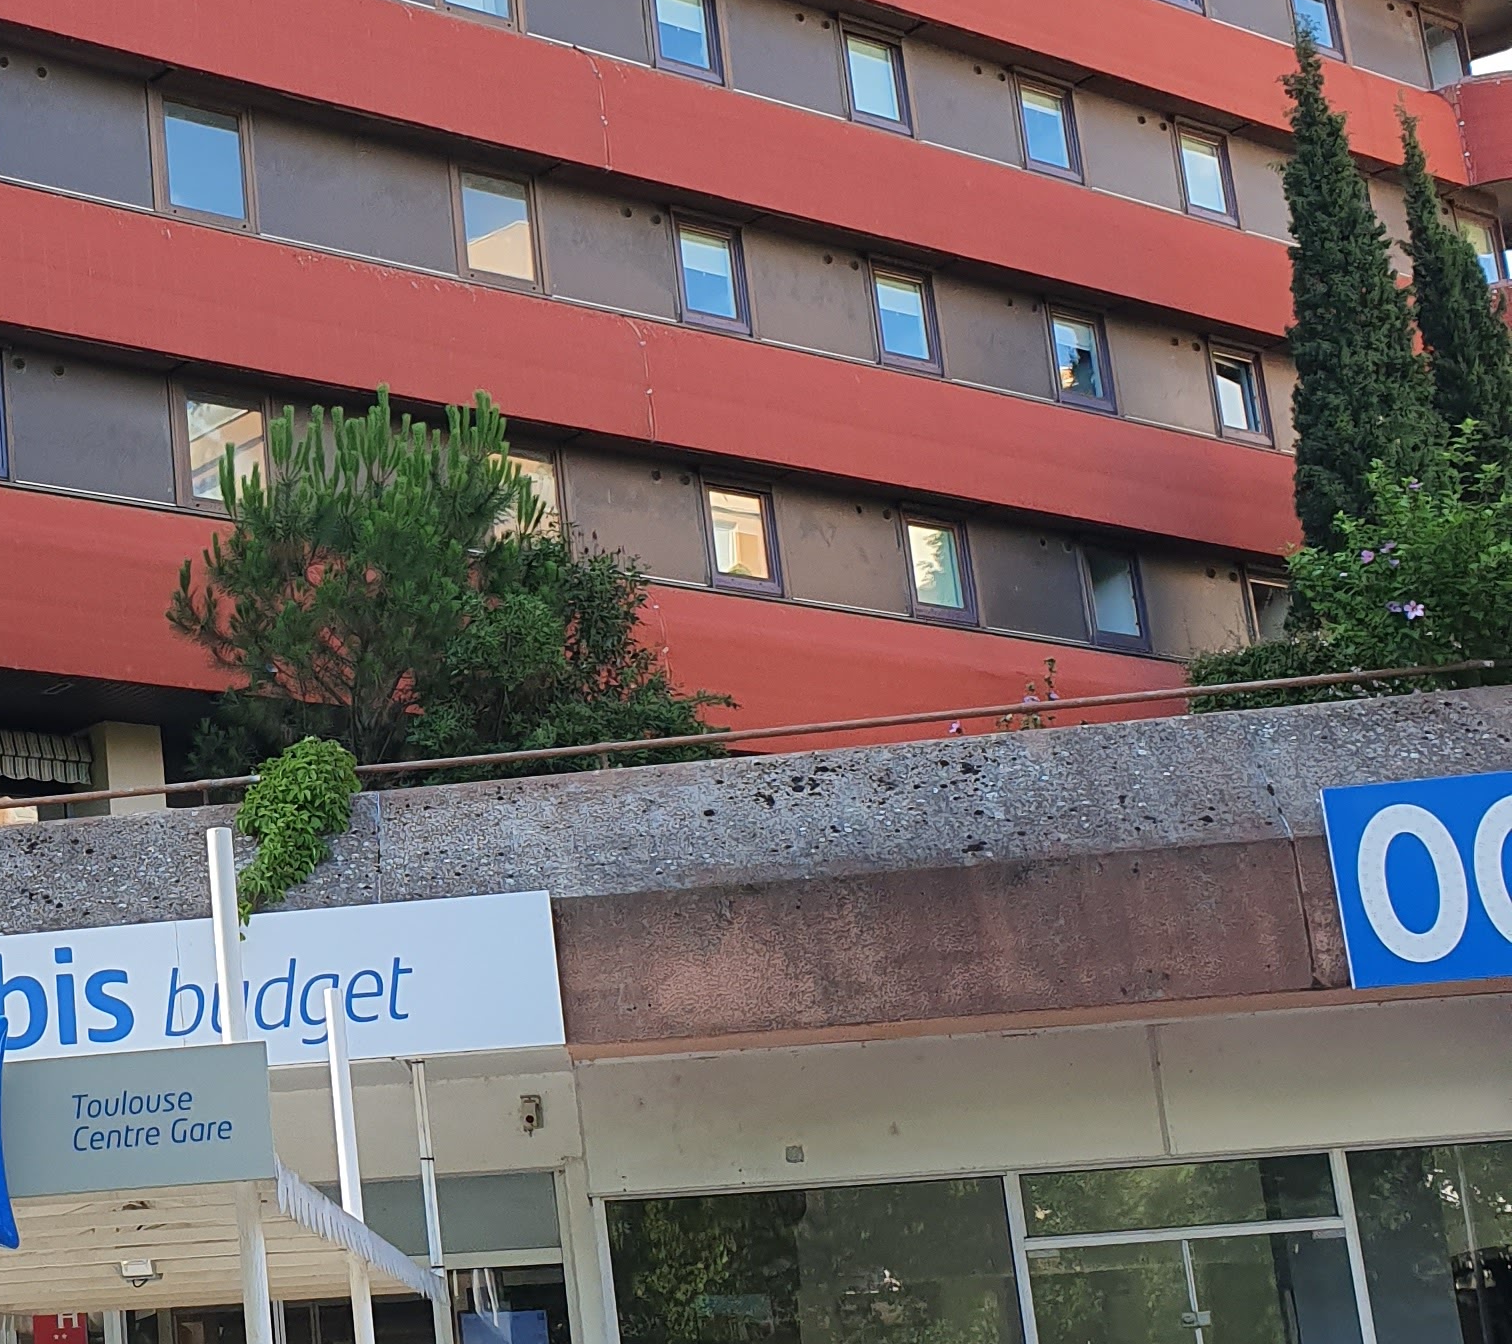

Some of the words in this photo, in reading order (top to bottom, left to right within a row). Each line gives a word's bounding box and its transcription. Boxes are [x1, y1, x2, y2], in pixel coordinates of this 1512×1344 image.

[72, 1090, 193, 1120] Toulouse
[73, 1125, 161, 1152] Centre
[171, 1118, 233, 1144] Gare
